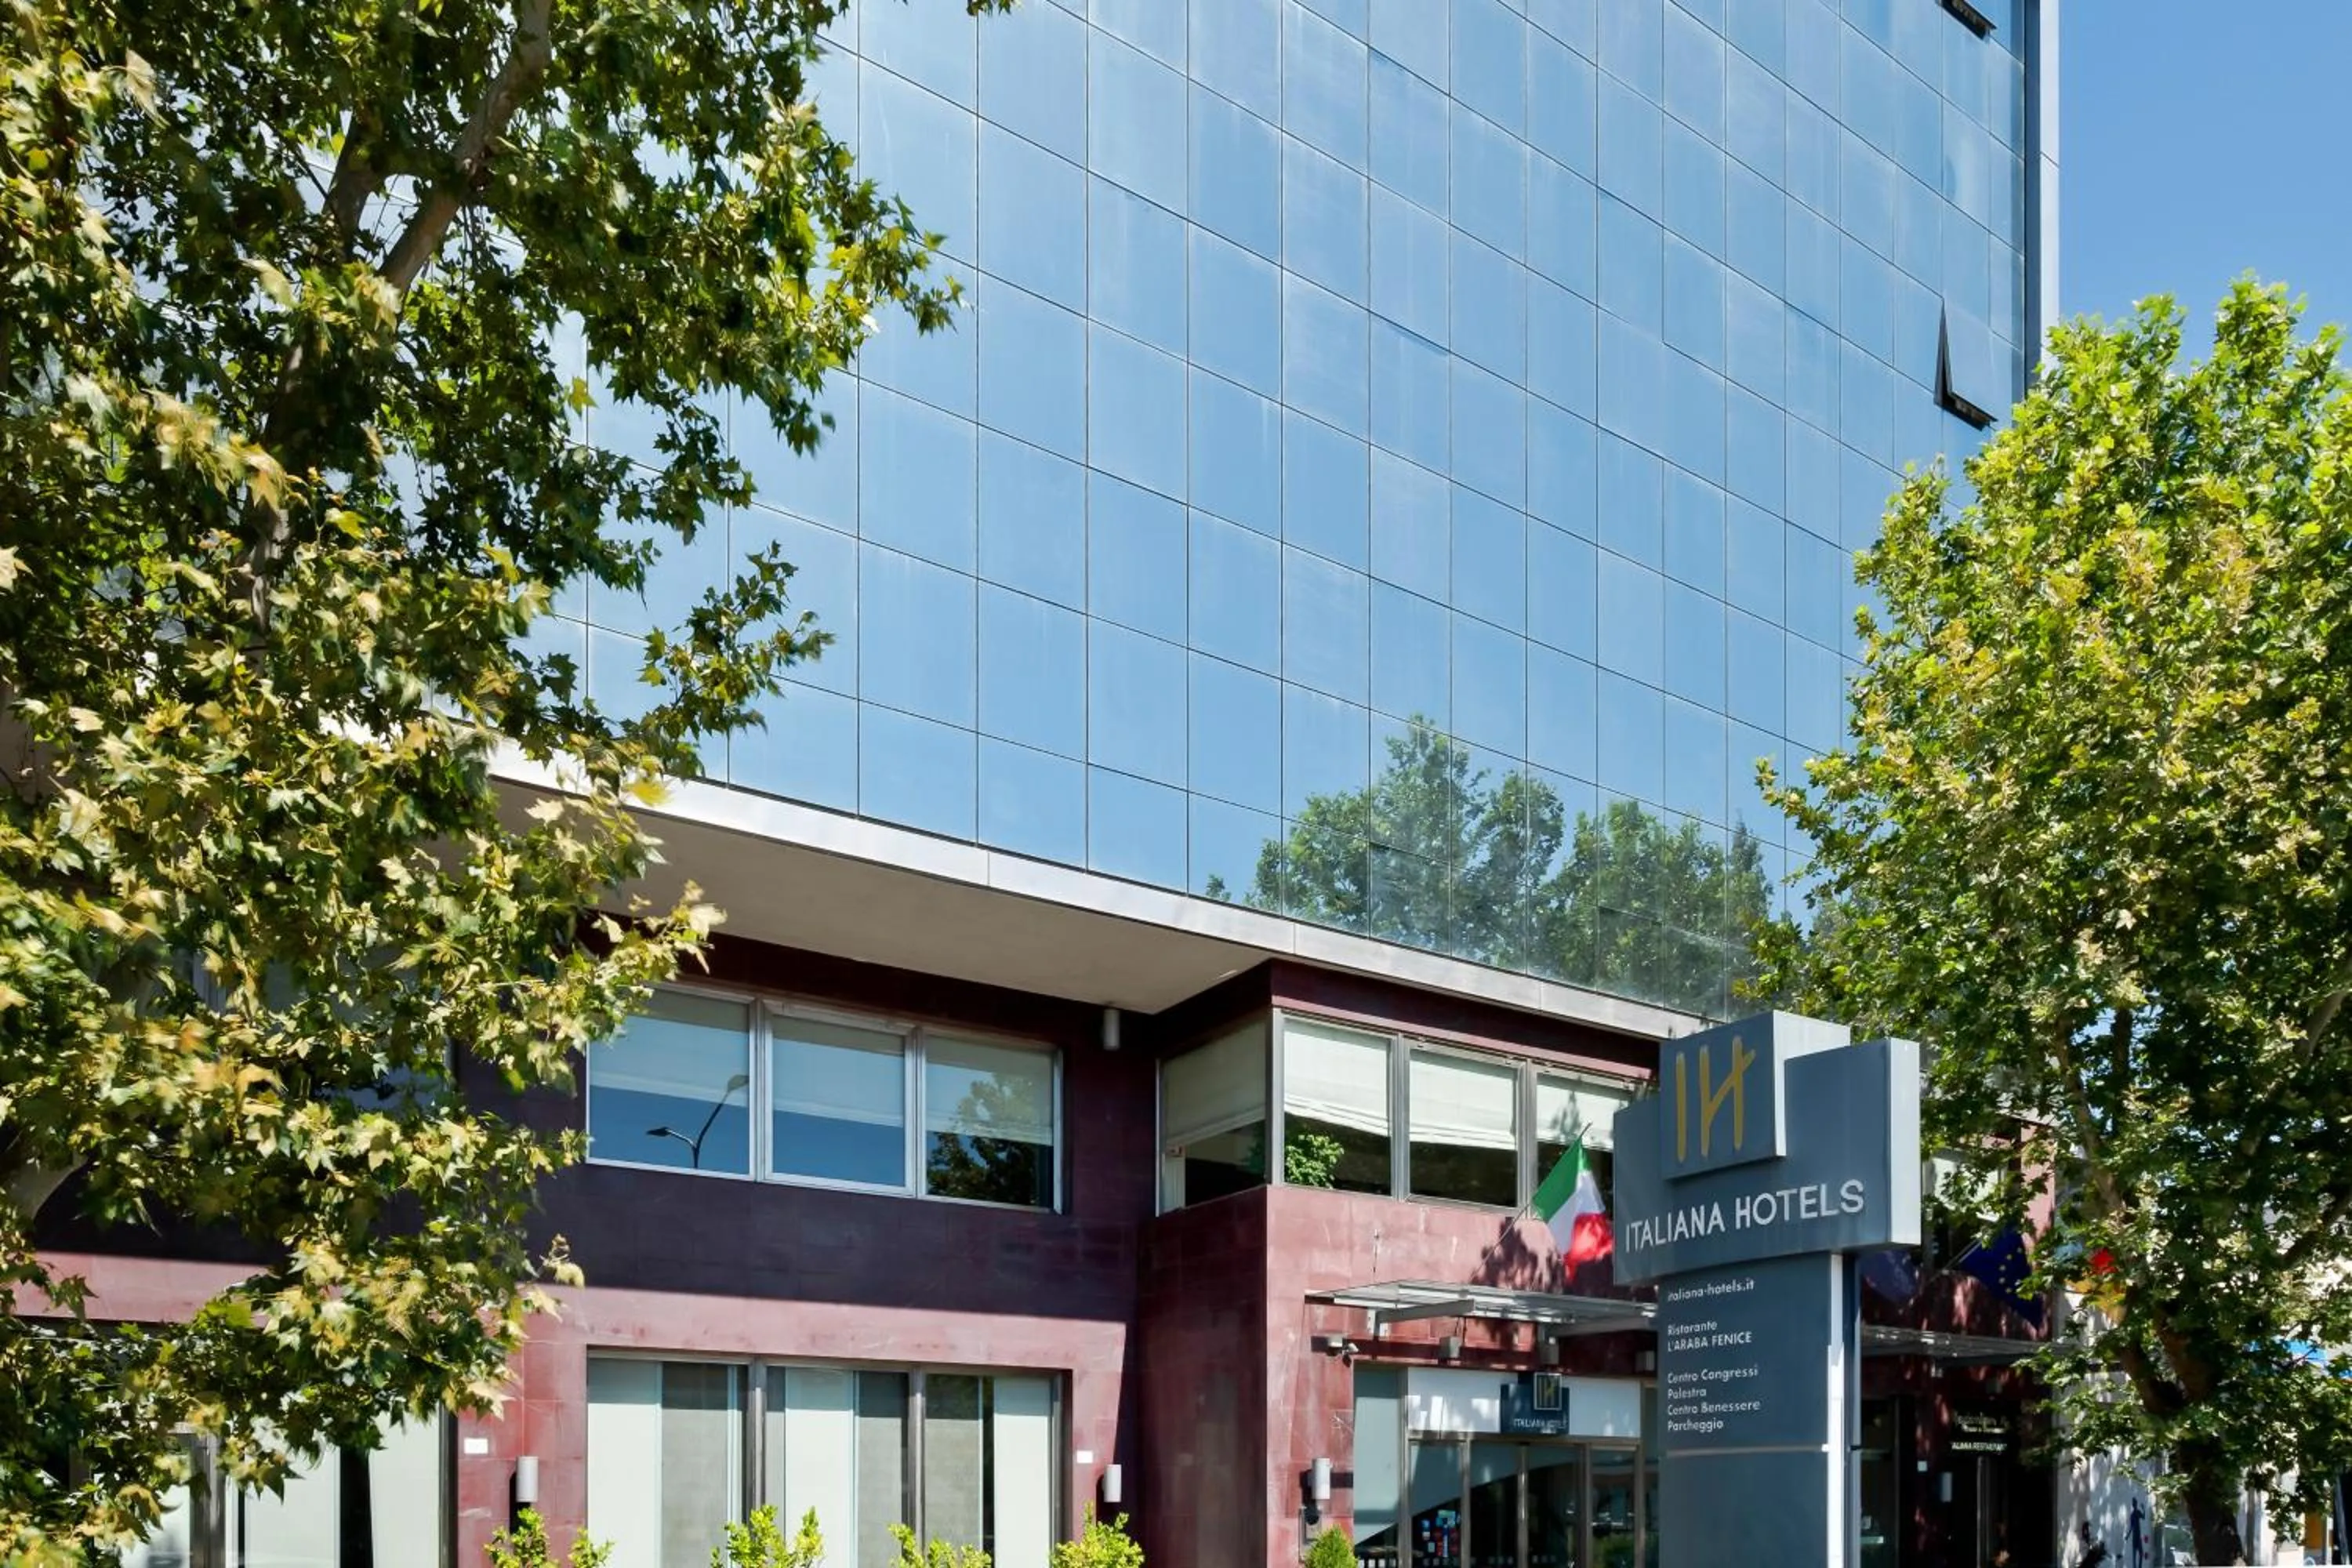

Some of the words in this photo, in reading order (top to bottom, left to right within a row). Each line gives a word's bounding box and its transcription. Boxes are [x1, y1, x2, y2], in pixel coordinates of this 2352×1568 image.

[1625, 1201, 1726, 1253] ITALIANA
[1735, 1178, 1864, 1229] HOTELS
[1668, 1321, 1718, 1336] Ristorante
[1668, 1336, 1708, 1352] L'ARABA
[1711, 1331, 1752, 1347] FENICE
[1668, 1372, 1698, 1384] Centro
[1700, 1363, 1759, 1382] Congressi
[1668, 1388, 1707, 1399] Palestra
[1668, 1404, 1697, 1416] Centro
[1700, 1400, 1761, 1414] Benessere
[1668, 1417, 1724, 1433] Parcheggio
